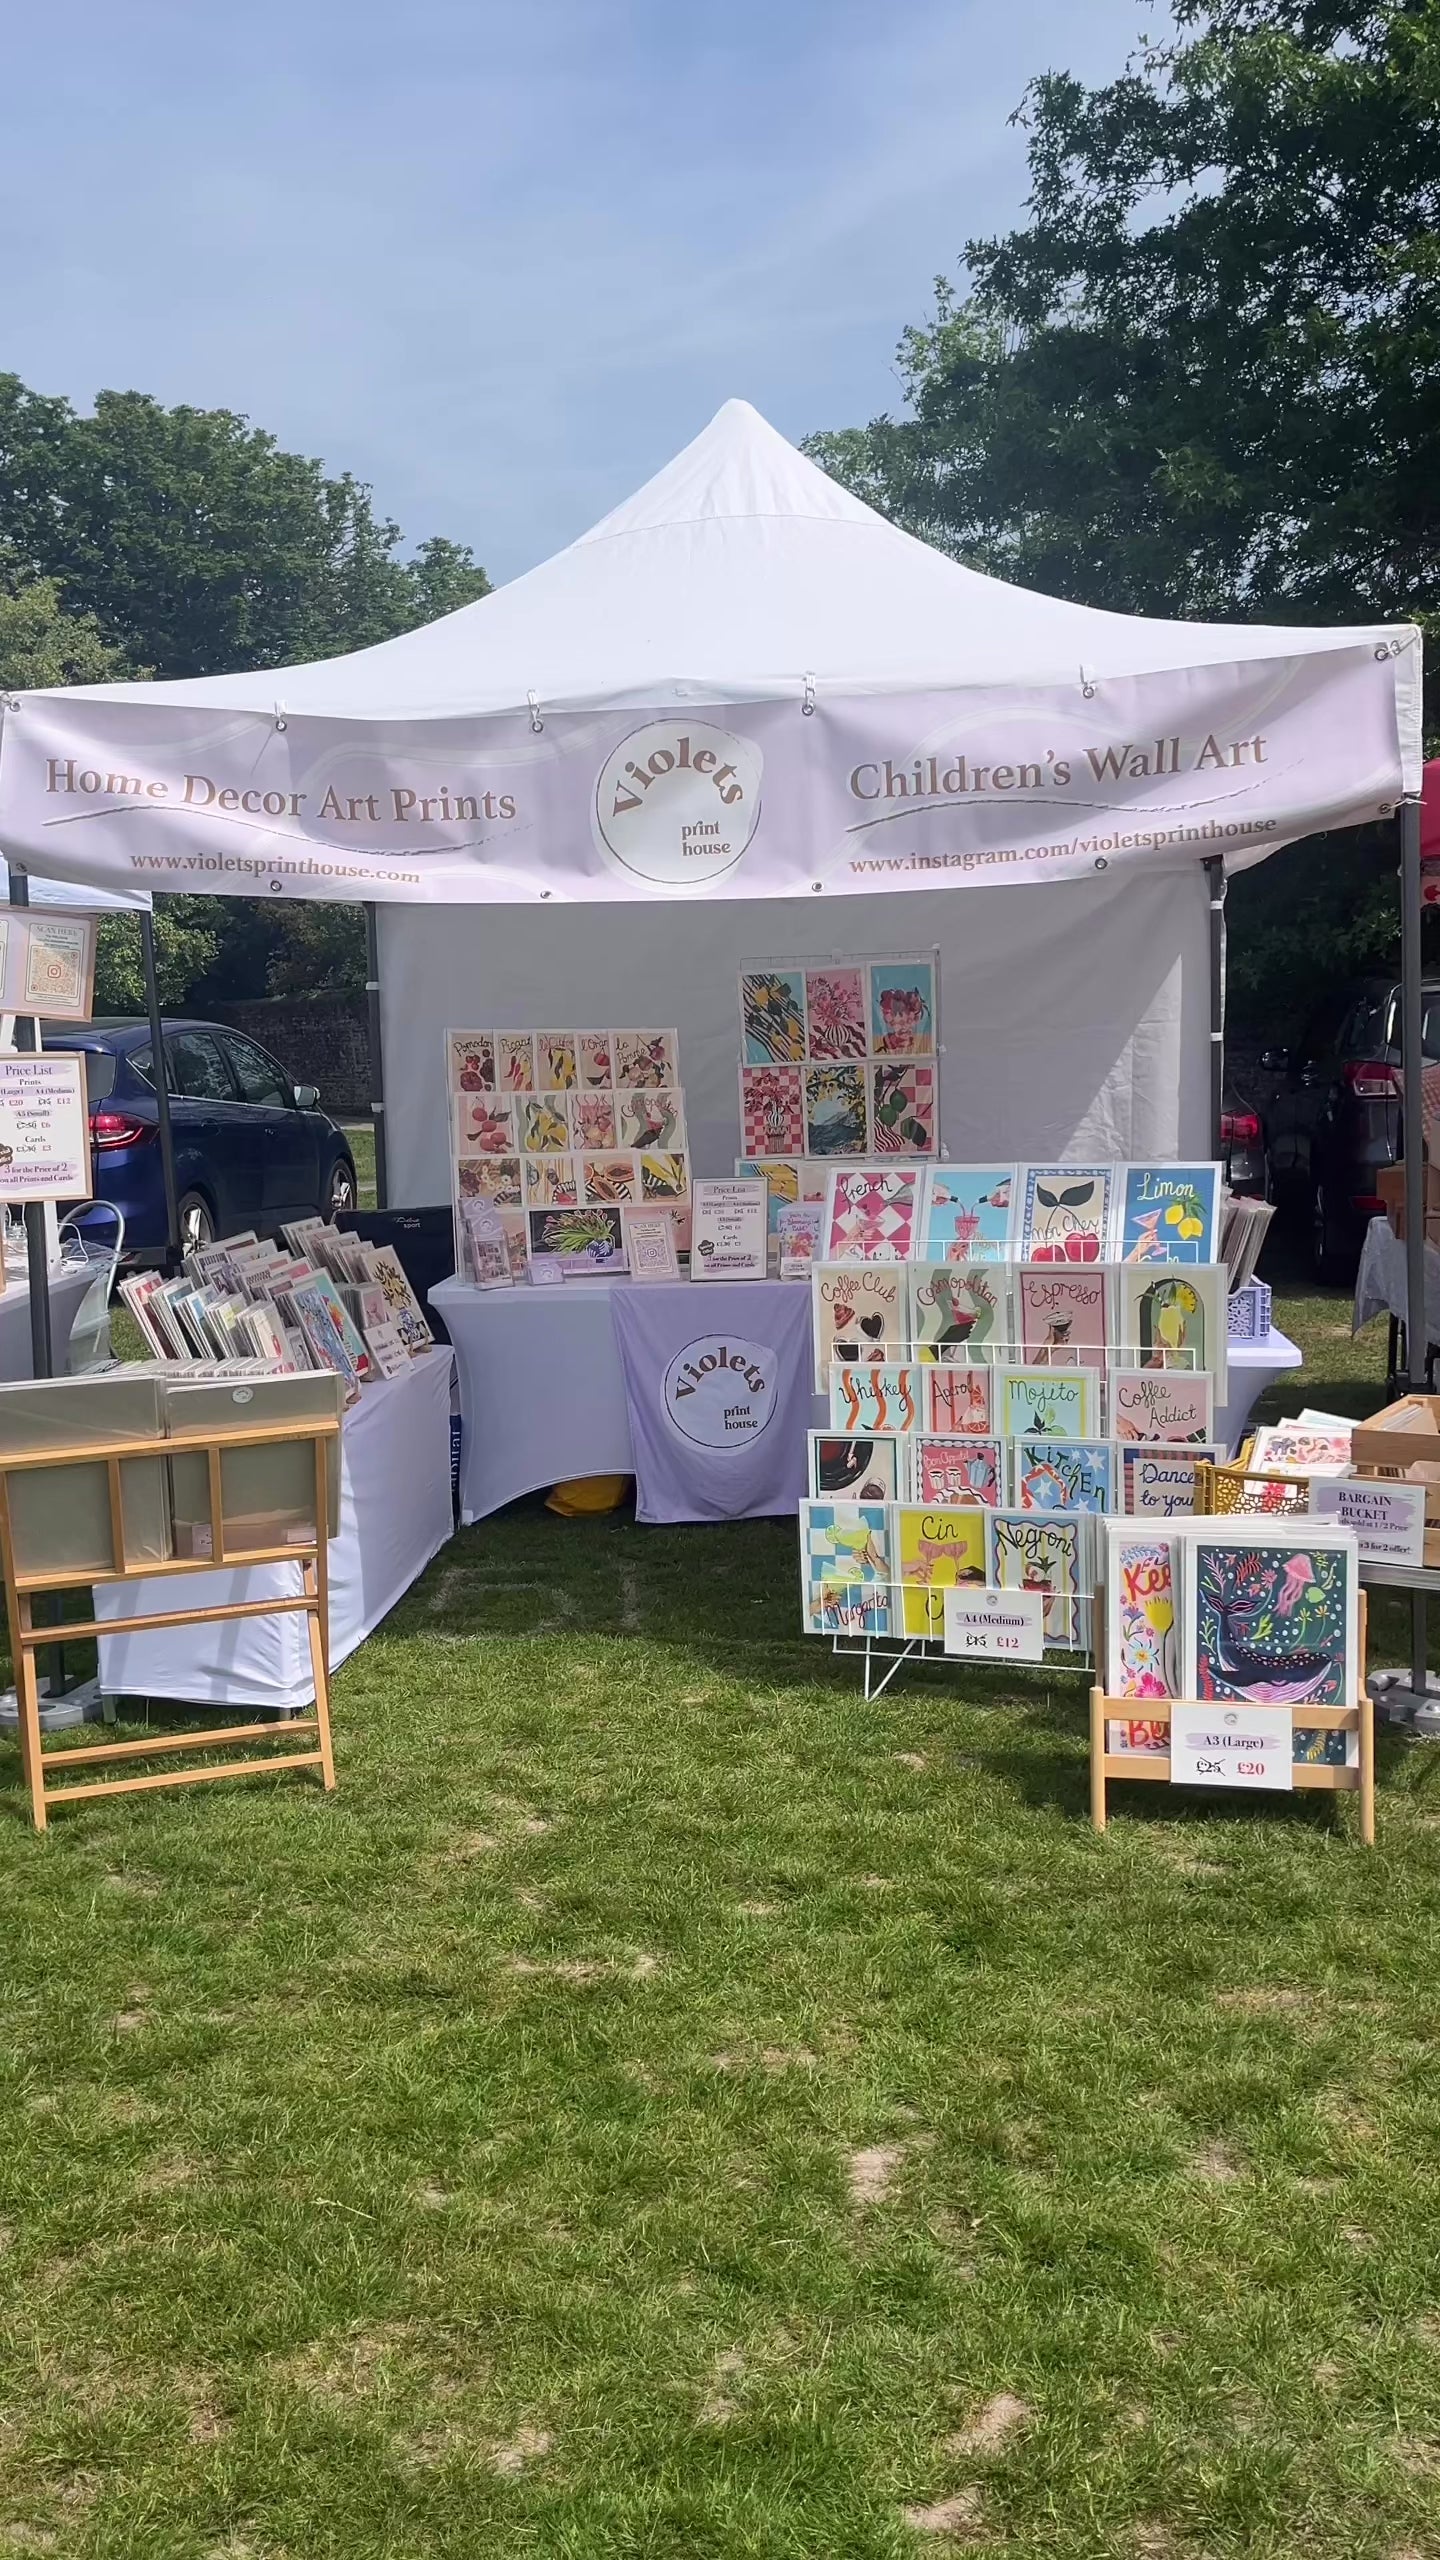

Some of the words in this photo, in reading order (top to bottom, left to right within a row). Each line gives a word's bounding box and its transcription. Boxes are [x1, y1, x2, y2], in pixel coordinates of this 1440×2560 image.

[613, 737, 743, 817] Violets
[850, 750, 1071, 799] Children’s
[1083, 737, 1181, 782] Wall
[1194, 734, 1268, 770] Art
[46, 759, 168, 798] Home
[181, 774, 307, 817] Decor
[317, 785, 381, 821] Art
[390, 786, 517, 822] Prints
[682, 821, 720, 840] print
[682, 842, 731, 857] house
[850, 819, 1276, 872] www.instagram.com/violetsprinthouse
[130, 852, 420, 883] www.violetsprinthouse.com
[6, 1066, 31, 1075] Price
[33, 1065, 52, 1075] List
[1136, 1172, 1195, 1200] Limon
[821, 1275, 861, 1303] Coffee
[862, 1271, 897, 1303] Club
[675, 1346, 765, 1401] Violets
[1009, 1380, 1079, 1412] Mojito
[1118, 1381, 1171, 1408] Coffee
[724, 1405, 751, 1419] print
[1149, 1404, 1197, 1428] Addict
[725, 1420, 758, 1430] house
[1139, 1463, 1194, 1484] Dance
[1140, 1490, 1161, 1506] to
[1339, 1492, 1392, 1505] BARGAIN
[1341, 1507, 1388, 1520] BUCKET
[922, 1516, 958, 1540] Cin
[994, 1520, 1074, 1558] Negroni
[964, 1613, 977, 1623] A4
[980, 1613, 1024, 1626] (Medium)
[997, 1637, 1019, 1648] £12
[1204, 1736, 1219, 1745] A3
[1223, 1736, 1264, 1750] (Large)
[1237, 1762, 1264, 1775] £20
